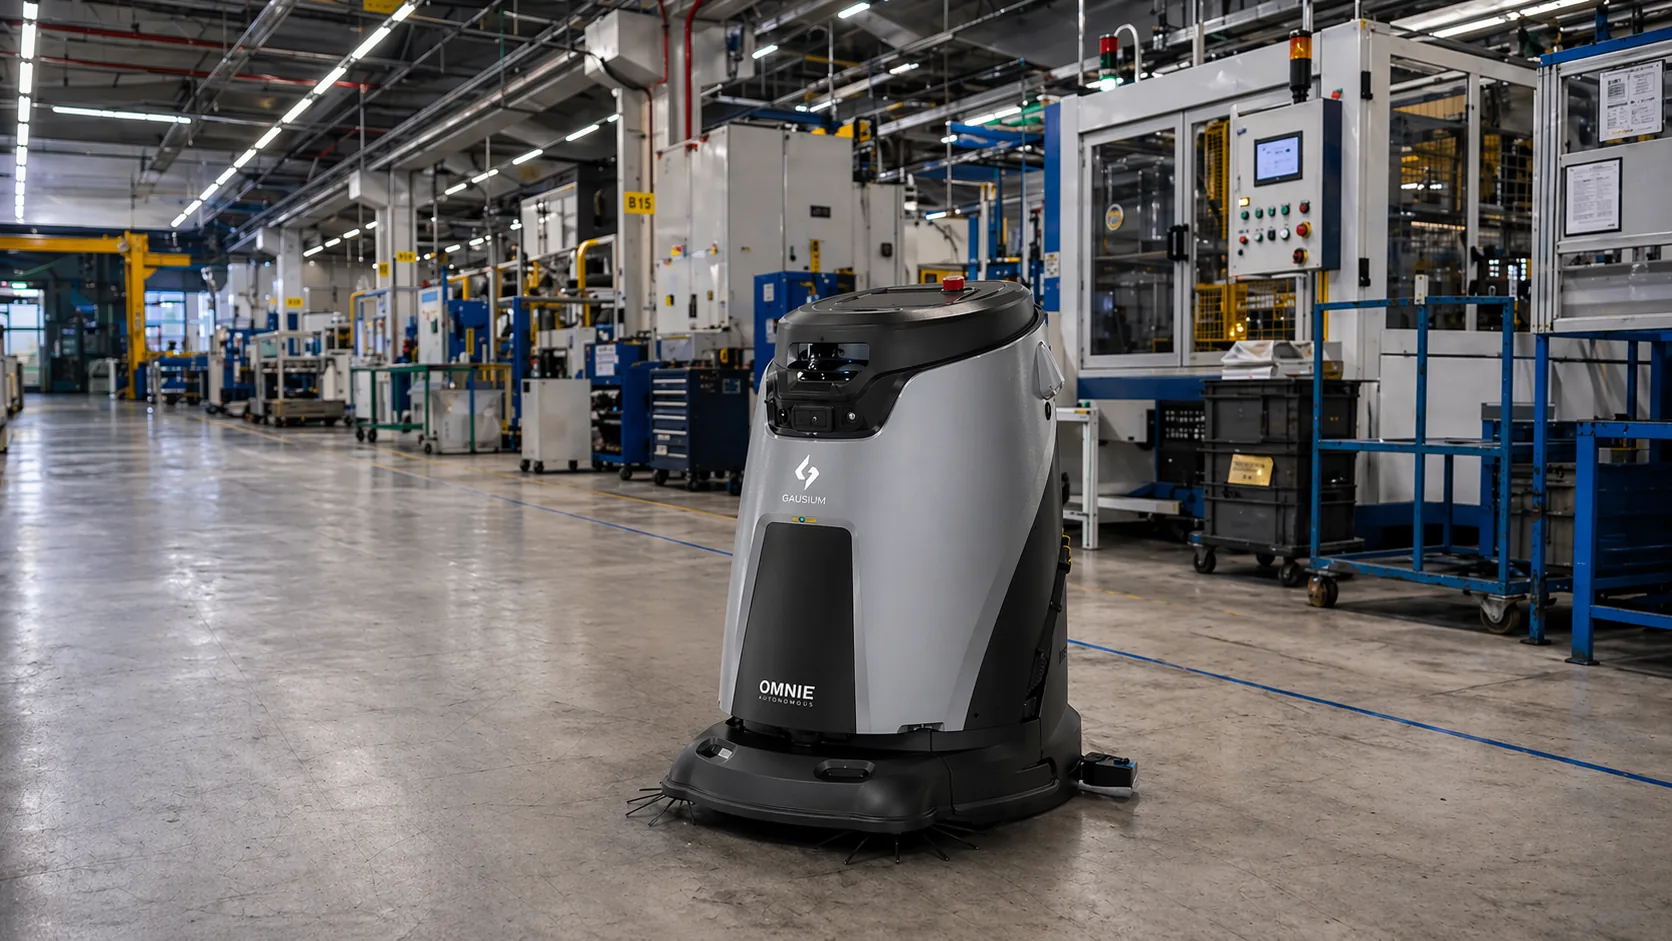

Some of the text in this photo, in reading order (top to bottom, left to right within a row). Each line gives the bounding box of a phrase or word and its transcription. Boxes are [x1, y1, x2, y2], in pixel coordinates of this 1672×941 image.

[628, 196, 652, 209] B15
[782, 494, 826, 505] GAUSIUM
[759, 680, 816, 700] OMNIE
